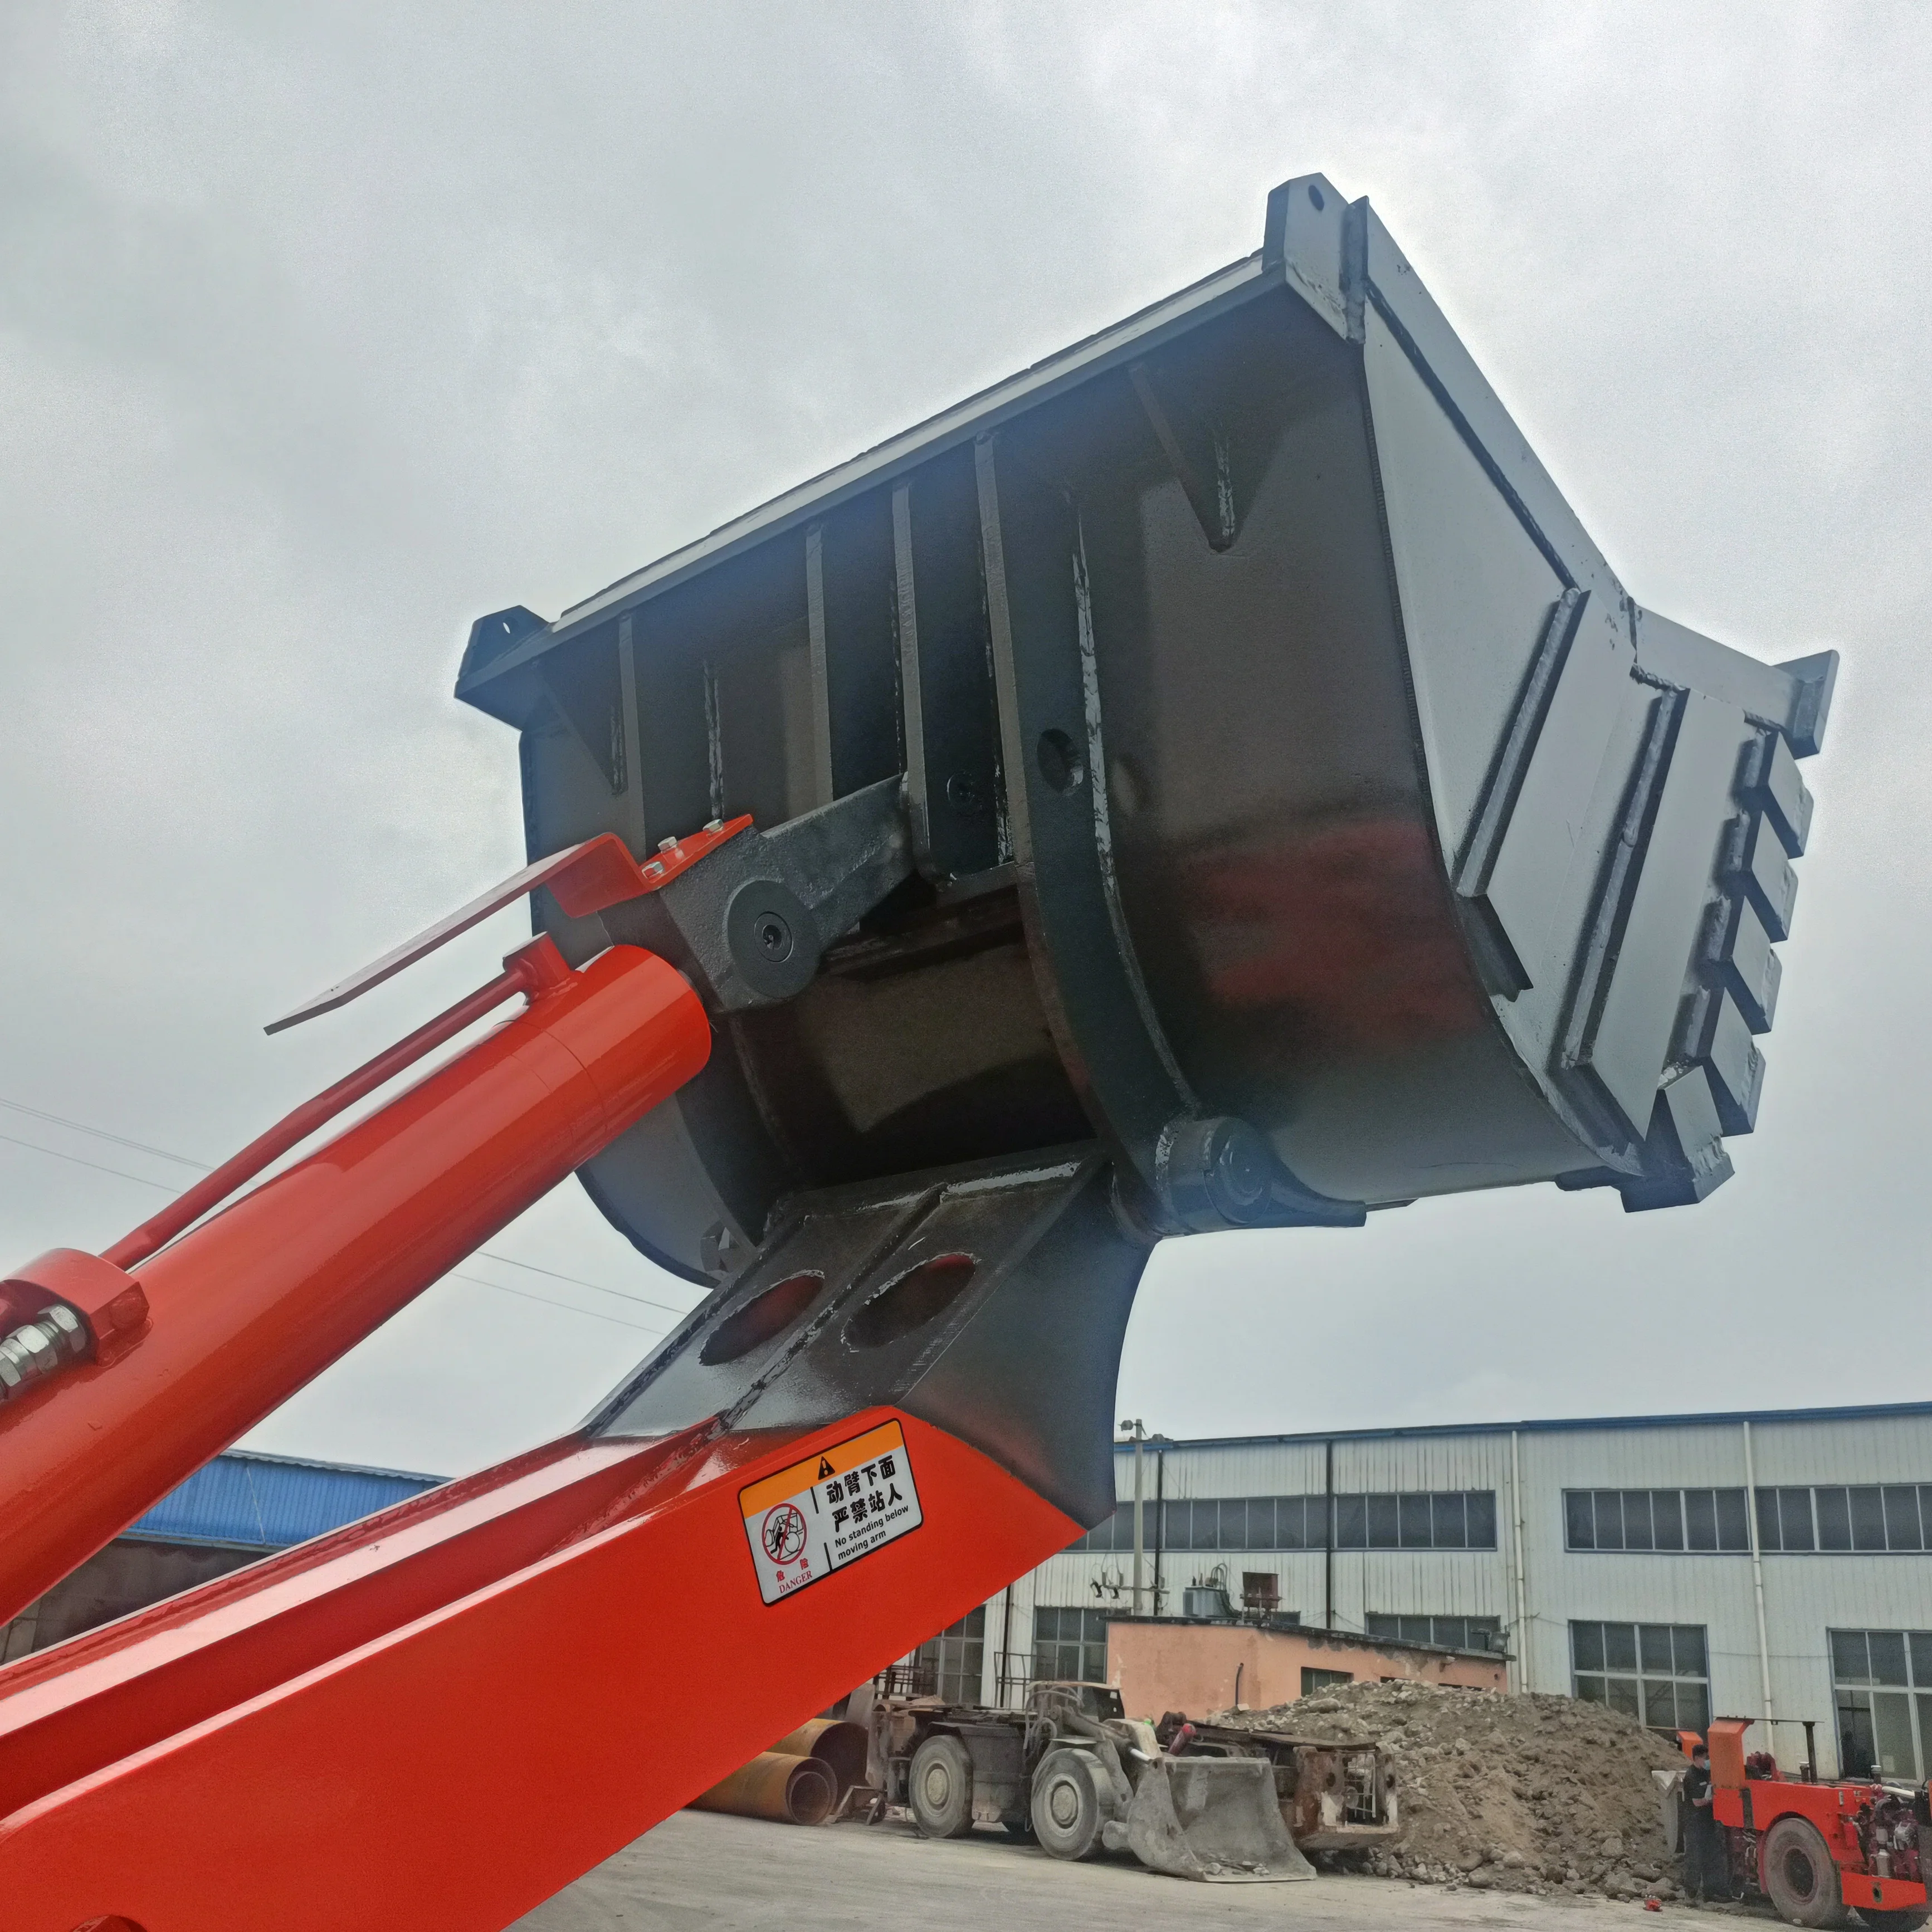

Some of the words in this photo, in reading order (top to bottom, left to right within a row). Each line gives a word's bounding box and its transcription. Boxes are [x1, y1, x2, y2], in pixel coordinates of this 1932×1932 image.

[826, 1455, 895, 1504] 动臂下面
[832, 1483, 902, 1532] 严禁站人
[835, 1536, 846, 1548] No
[849, 1518, 884, 1541] standing
[885, 1505, 909, 1522] below
[838, 1540, 869, 1560] moving
[870, 1530, 886, 1544] arm
[779, 1570, 813, 1594] DANGER
